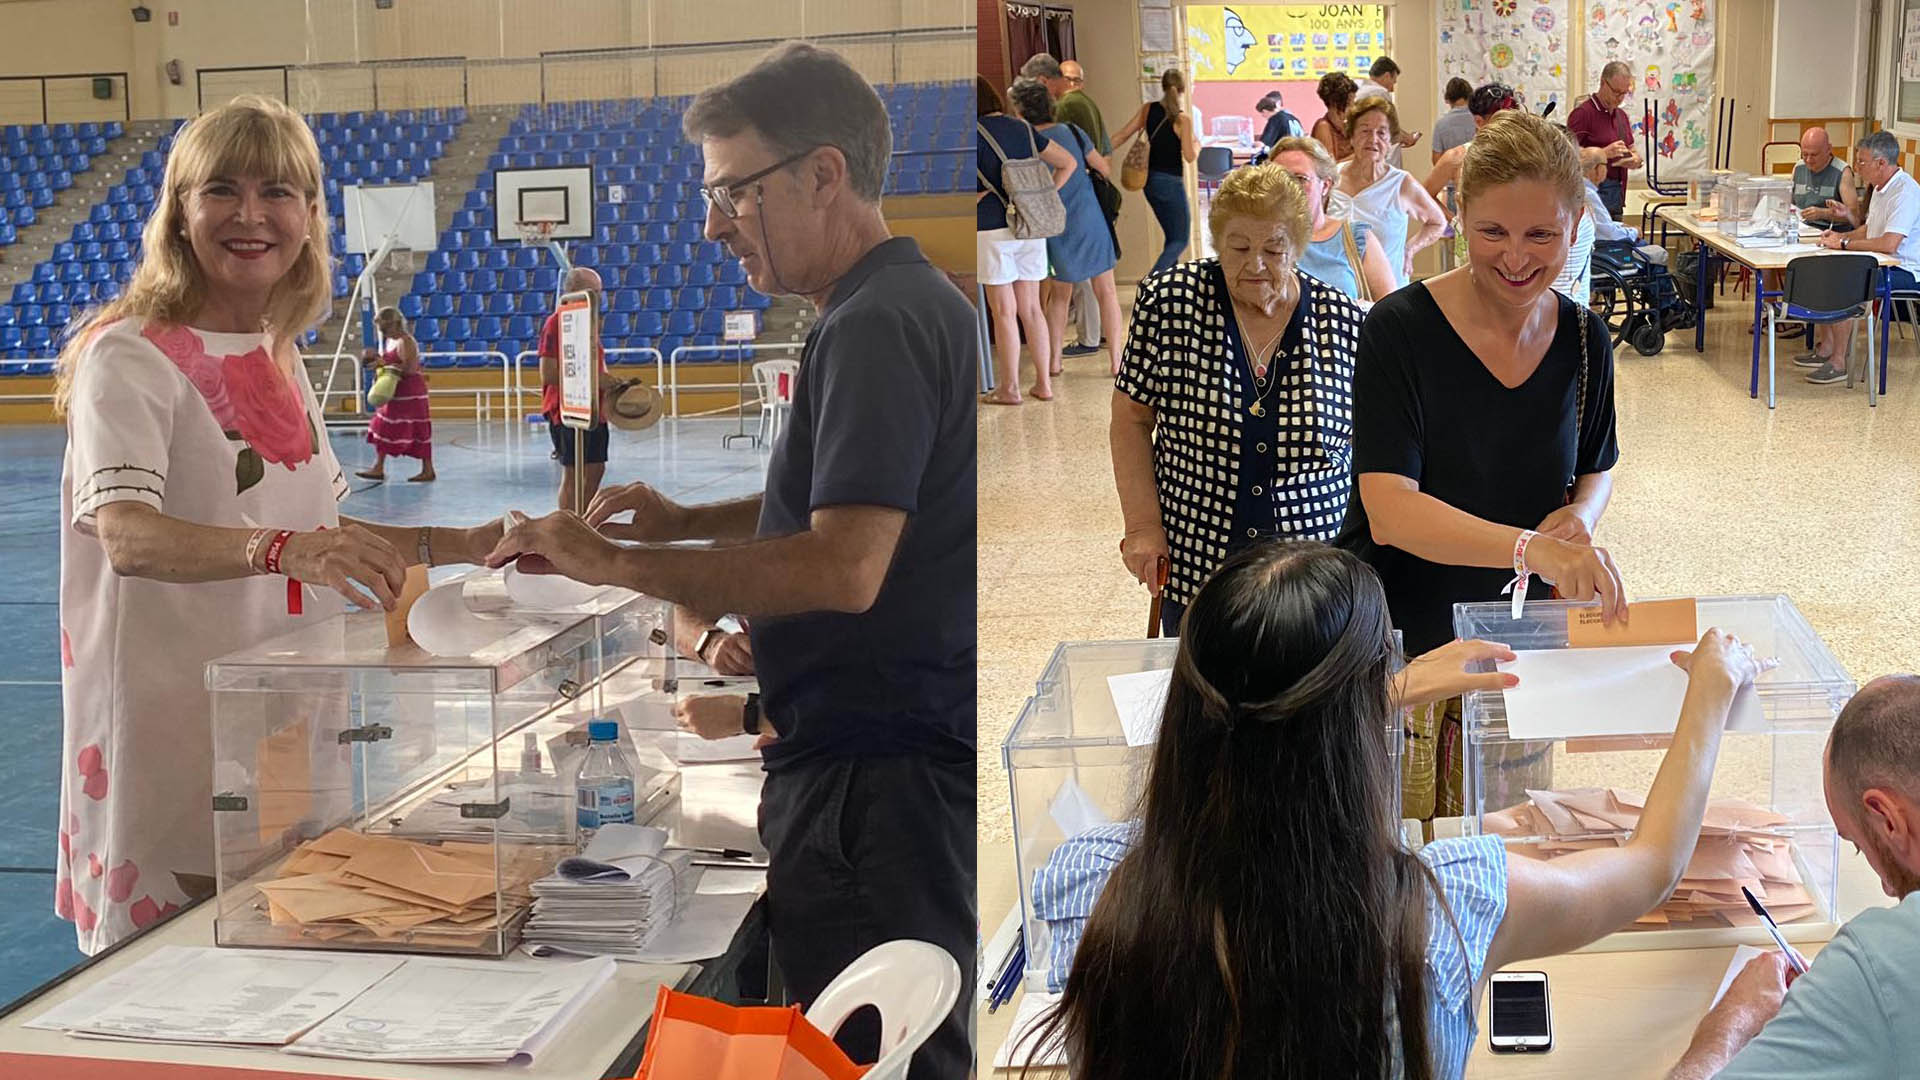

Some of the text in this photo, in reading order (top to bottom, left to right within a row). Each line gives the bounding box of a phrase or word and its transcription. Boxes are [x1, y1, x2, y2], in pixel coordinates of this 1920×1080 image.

[1319, 4, 1363, 17] JOAN
[1310, 19, 1330, 29] 100
[1336, 18, 1364, 29] ANYS
